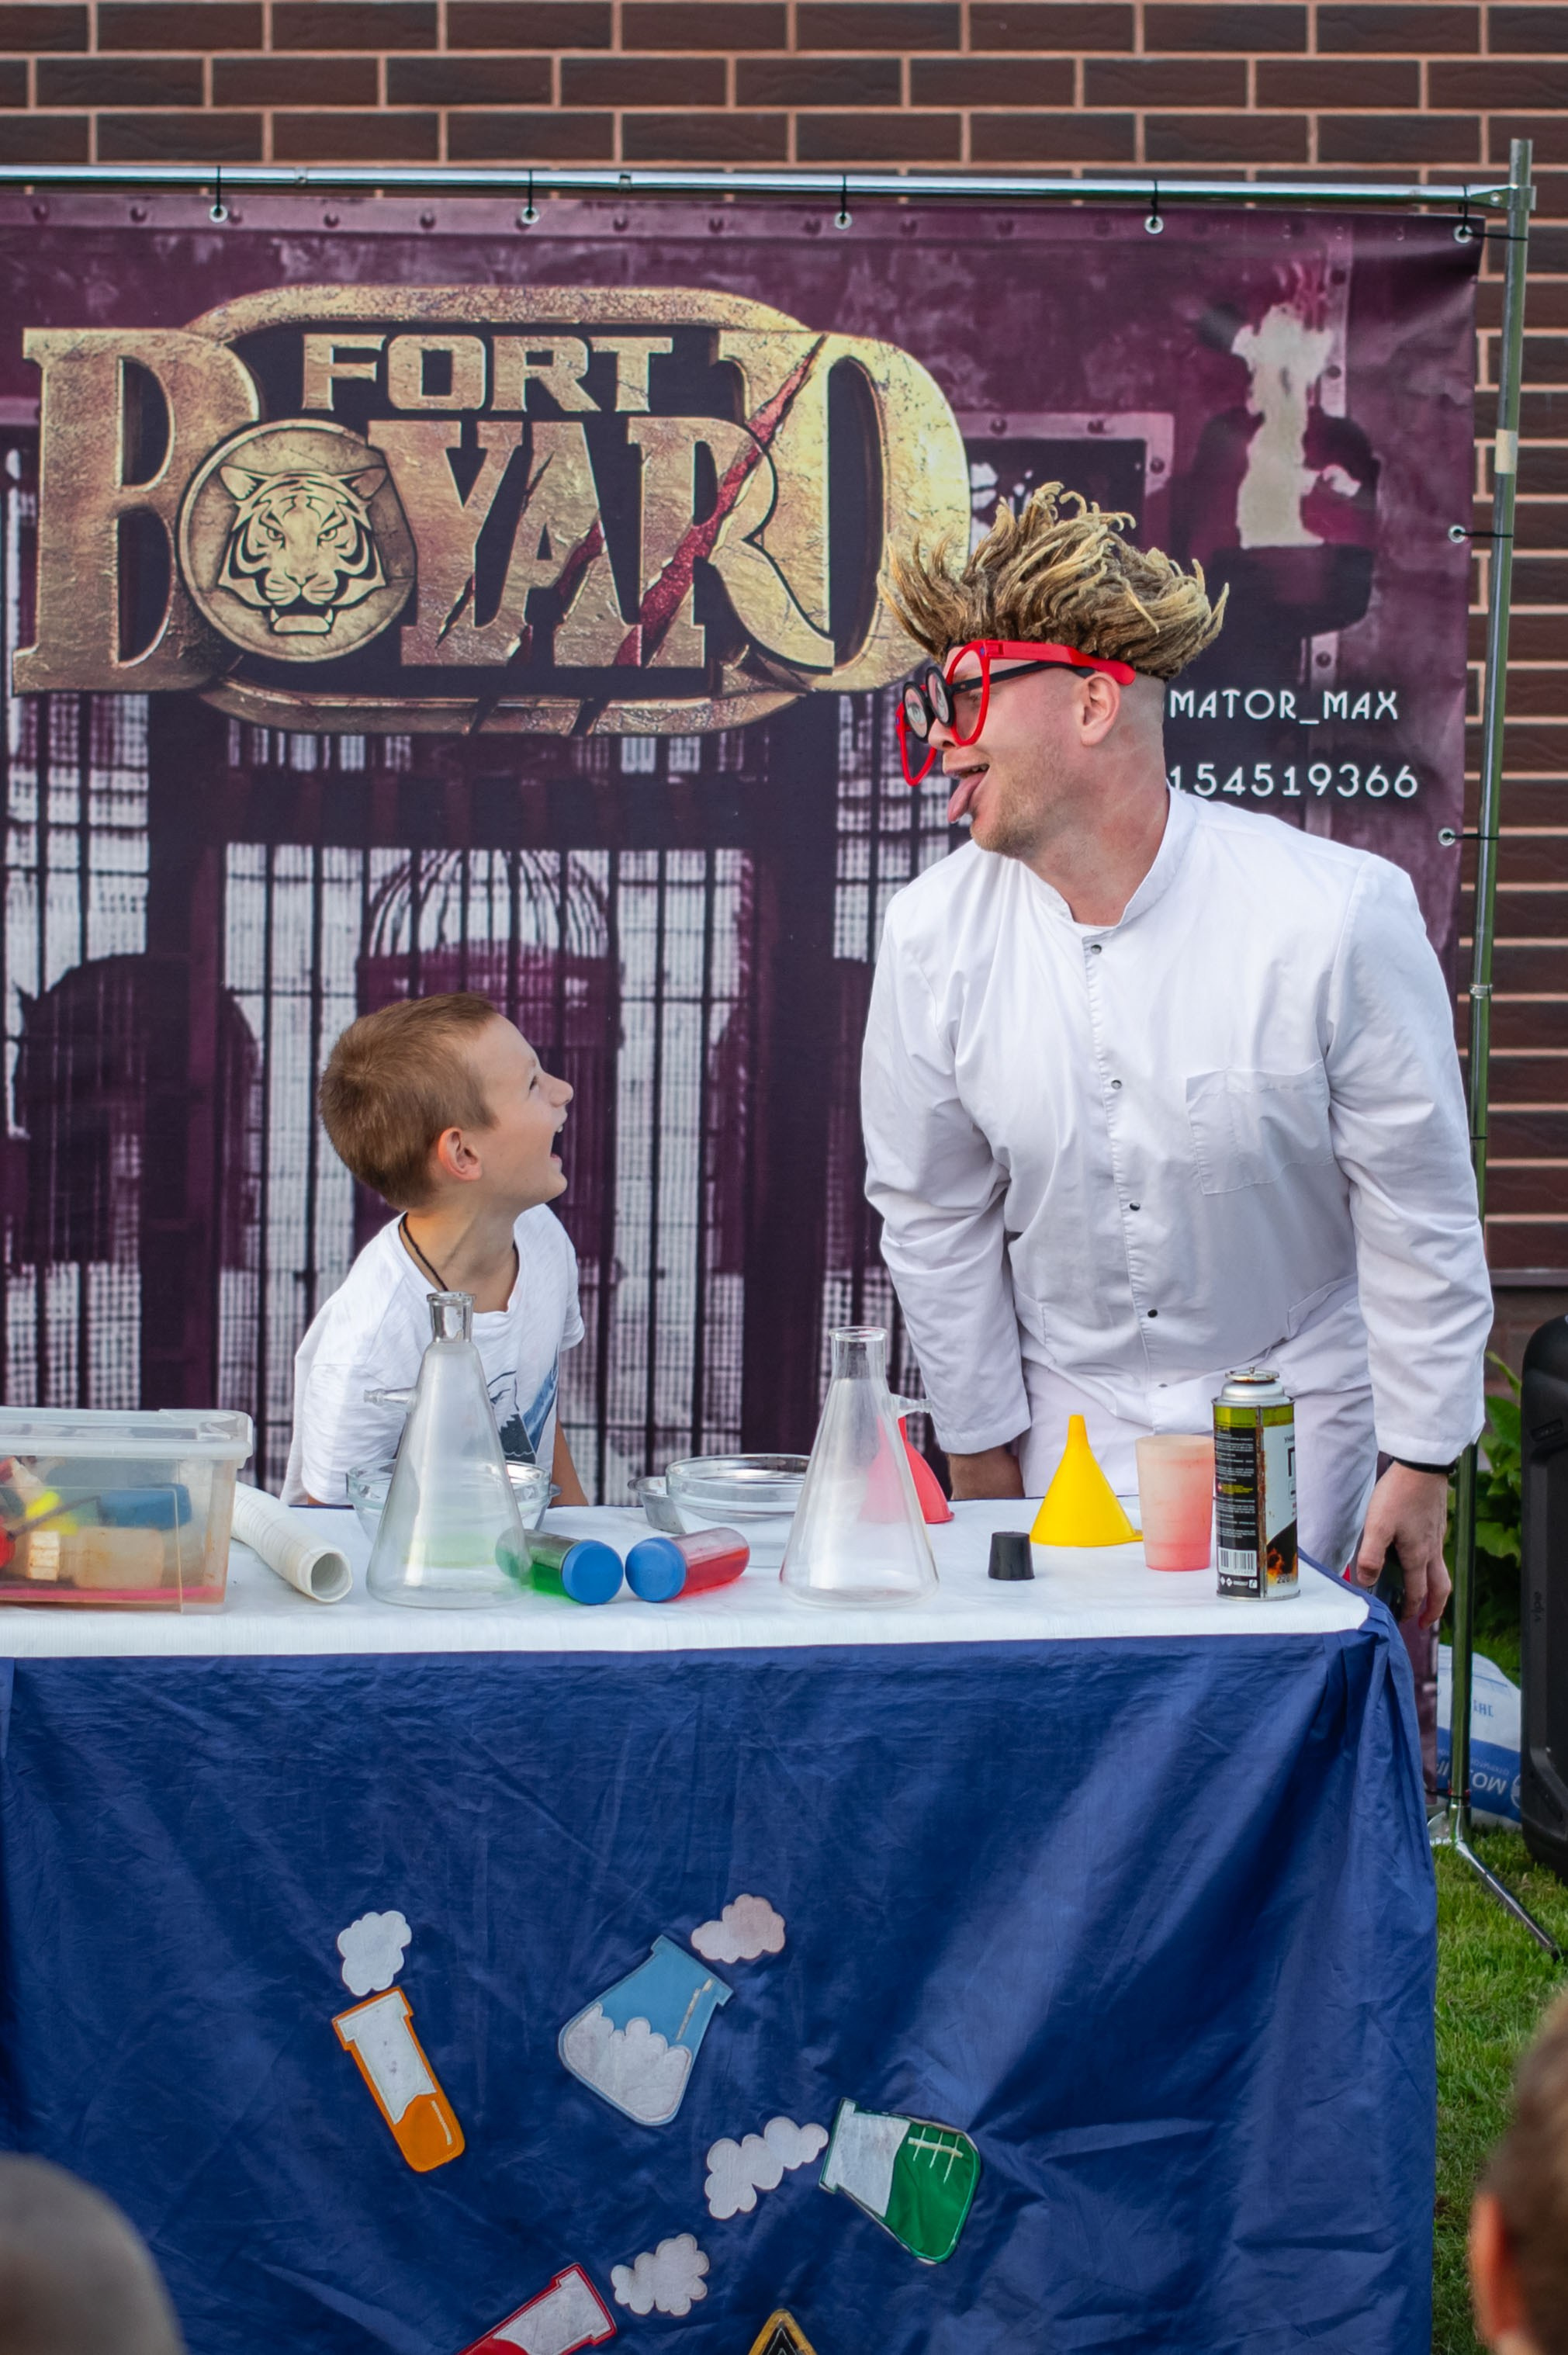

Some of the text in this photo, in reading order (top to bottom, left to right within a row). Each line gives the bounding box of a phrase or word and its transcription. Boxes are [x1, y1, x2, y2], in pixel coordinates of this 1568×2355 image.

[302, 333, 673, 413] FORT
[1169, 689, 1398, 725] MATOR_MAX
[1169, 763, 1418, 798] 154519366
